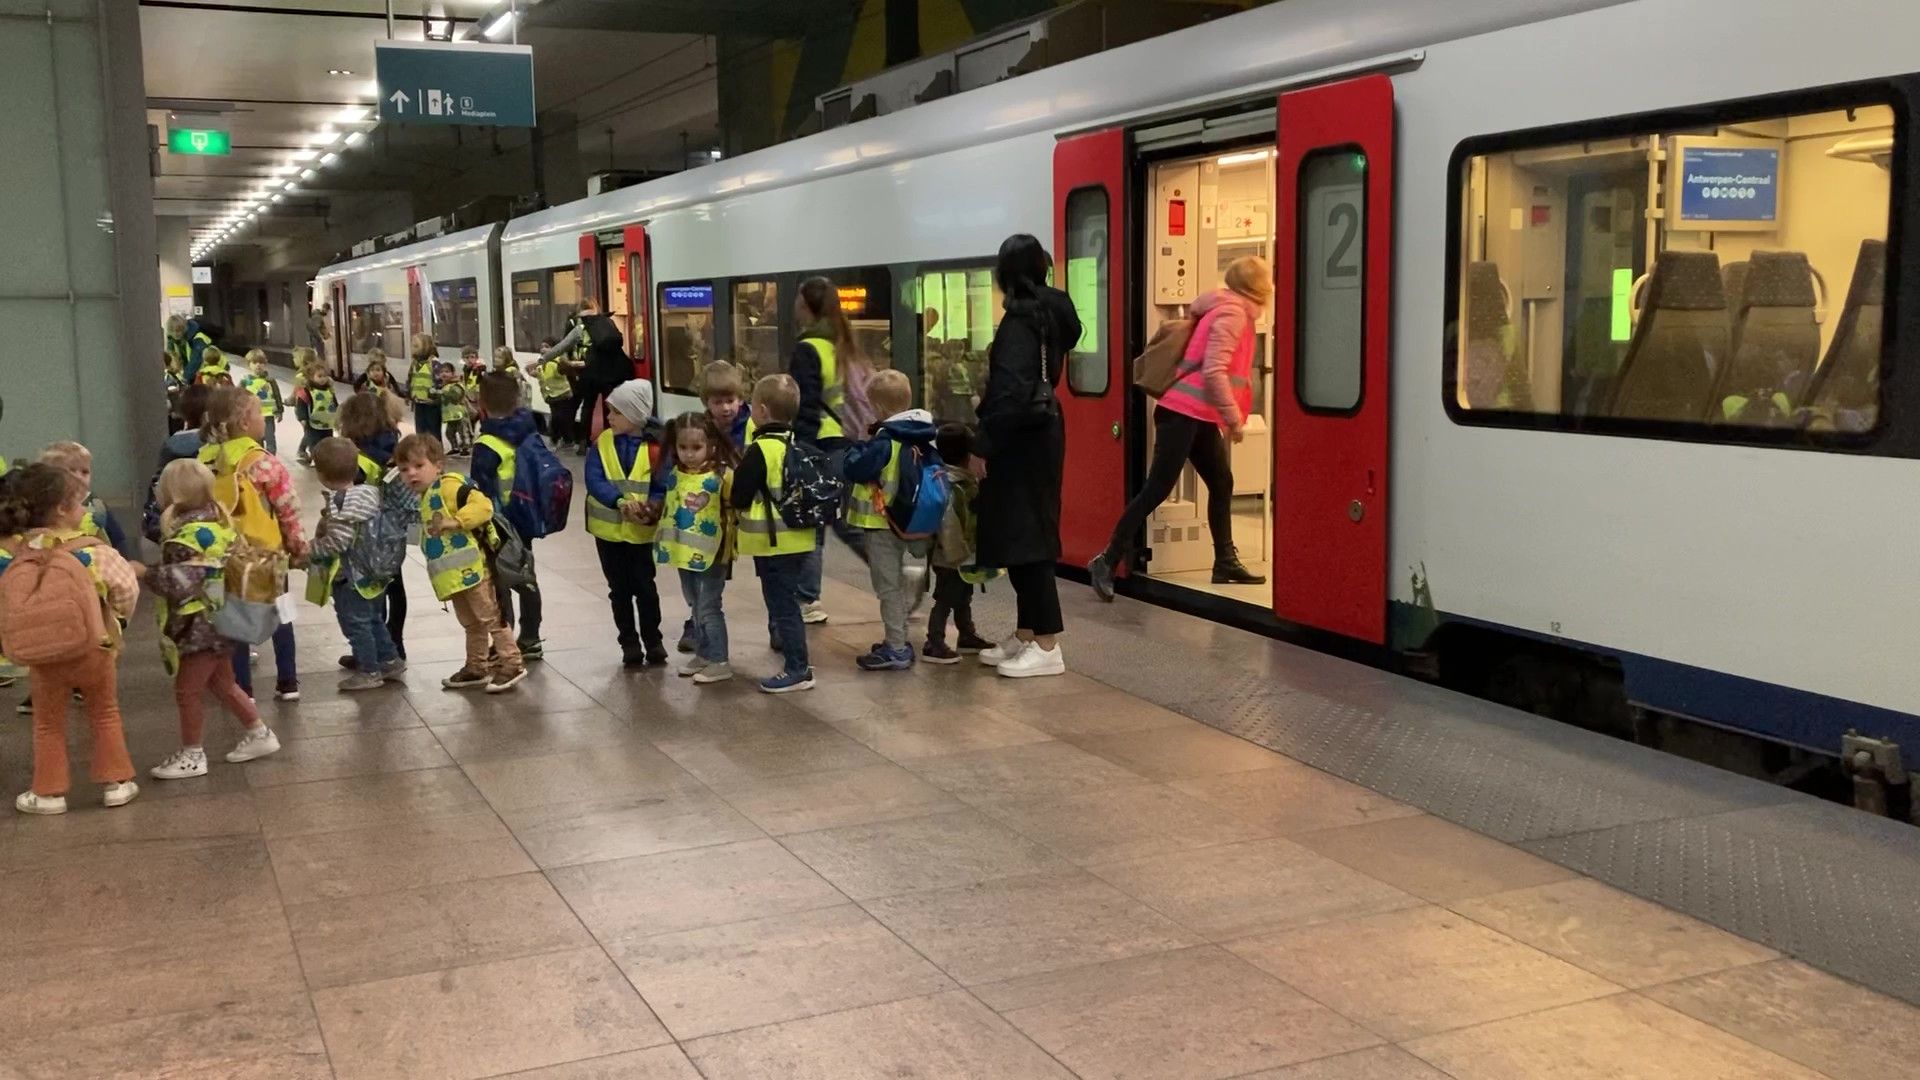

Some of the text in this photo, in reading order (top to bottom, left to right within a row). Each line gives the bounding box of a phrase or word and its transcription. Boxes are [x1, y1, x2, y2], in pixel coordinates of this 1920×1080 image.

[1687, 173, 1771, 185] Antwerpen-Centraal
[1235, 217, 1242, 228] 2
[1326, 202, 1359, 278] 2
[1551, 621, 1561, 633] 12
